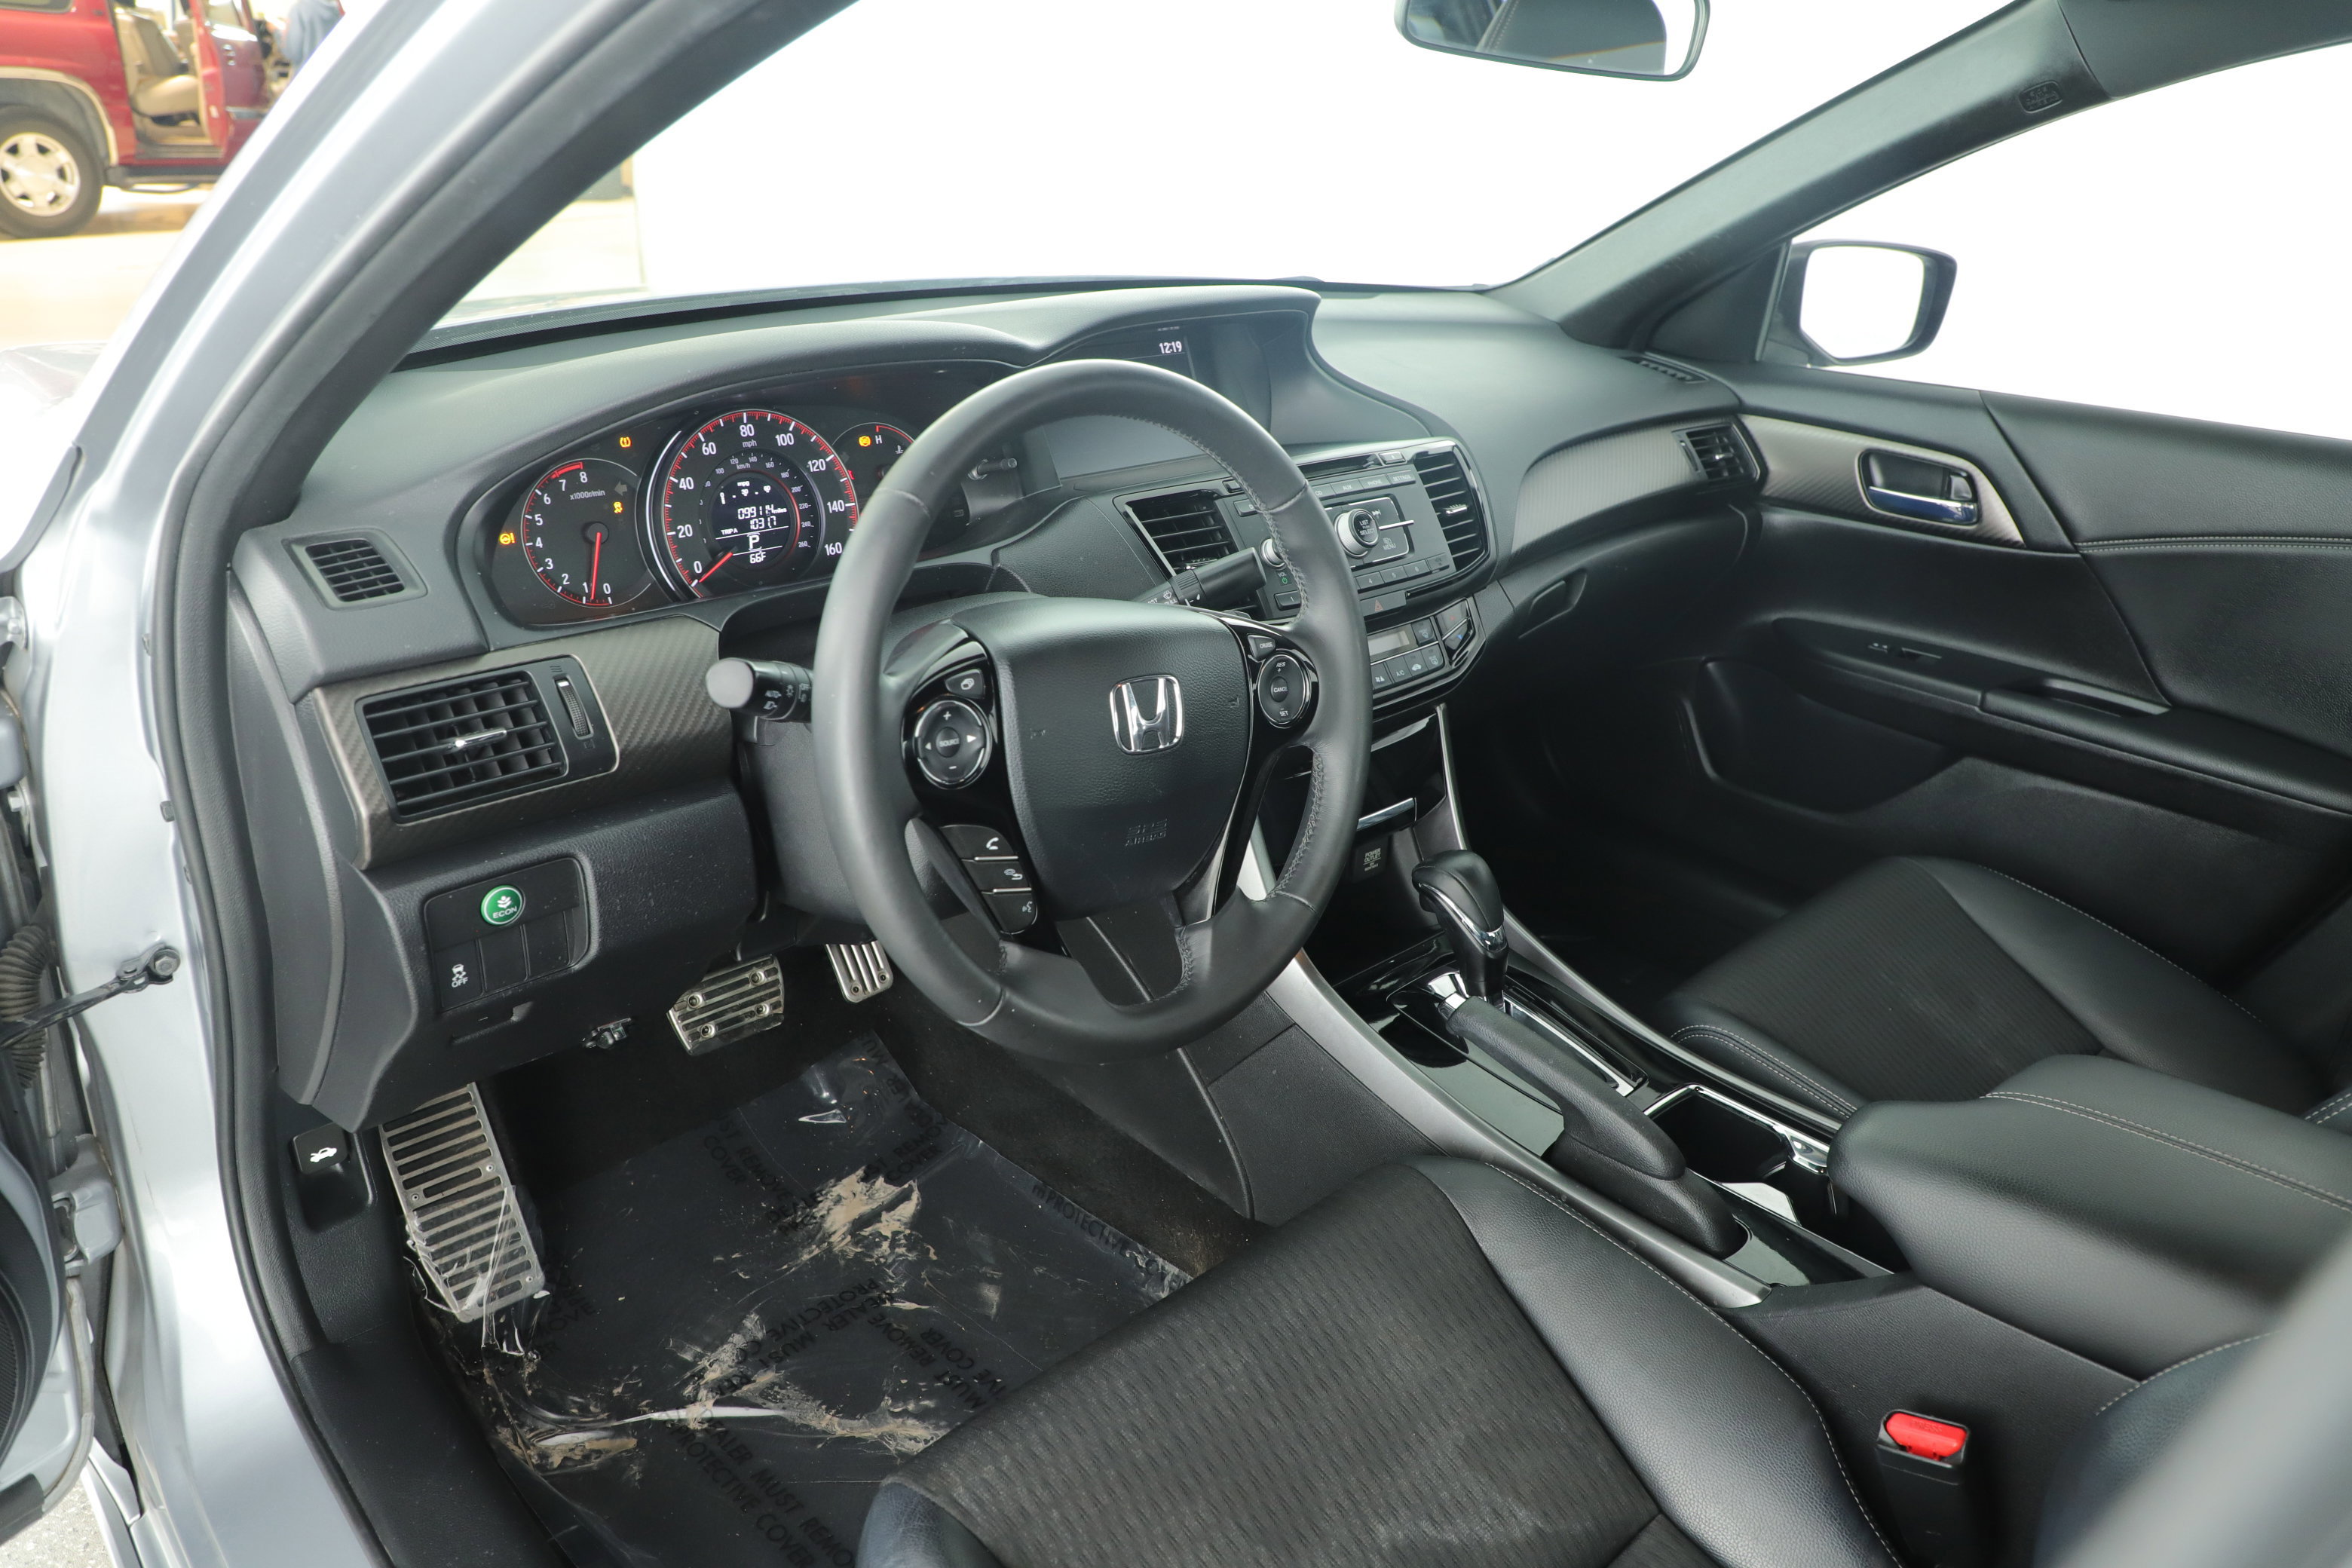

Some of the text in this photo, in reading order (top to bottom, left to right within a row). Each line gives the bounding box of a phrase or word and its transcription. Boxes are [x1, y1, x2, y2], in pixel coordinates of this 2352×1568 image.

[1159, 341, 1182, 354] 12:19
[740, 424, 755, 437] 80
[743, 439, 757, 449] mph
[775, 433, 795, 446] 100
[874, 434, 883, 445] H
[702, 442, 716, 455] 60
[807, 458, 826, 473] 120
[580, 471, 588, 483] 8
[559, 479, 566, 492] 7
[678, 477, 694, 491] 40
[544, 493, 551, 505] 6
[570, 489, 605, 501] x1000r/min
[827, 499, 845, 513] 140
[534, 513, 544, 526] 5
[678, 524, 693, 538] 20
[535, 537, 544, 548] 4
[749, 534, 760, 550] P
[824, 542, 843, 556] 160
[545, 558, 553, 570] 3
[694, 561, 702, 574] 0
[562, 574, 570, 585] 2
[582, 582, 589, 593] 1
[603, 583, 611, 595] 0
[939, 738, 960, 748] SOURCE
[1364, 854, 1381, 863] OUTLET
[1365, 848, 1381, 857] POWER
[492, 906, 517, 919] ECON
[452, 977, 468, 988] OFF
[703, 1135, 748, 1187] COVER
[887, 1144, 943, 1182] COVER
[766, 1278, 880, 1343] PROTECTIVE
[868, 1313, 936, 1368] REMOVE
[758, 1330, 817, 1369] MUST
[920, 1328, 975, 1370] COVER
[751, 1468, 804, 1514] MUST
[756, 1513, 815, 1568] COVER
